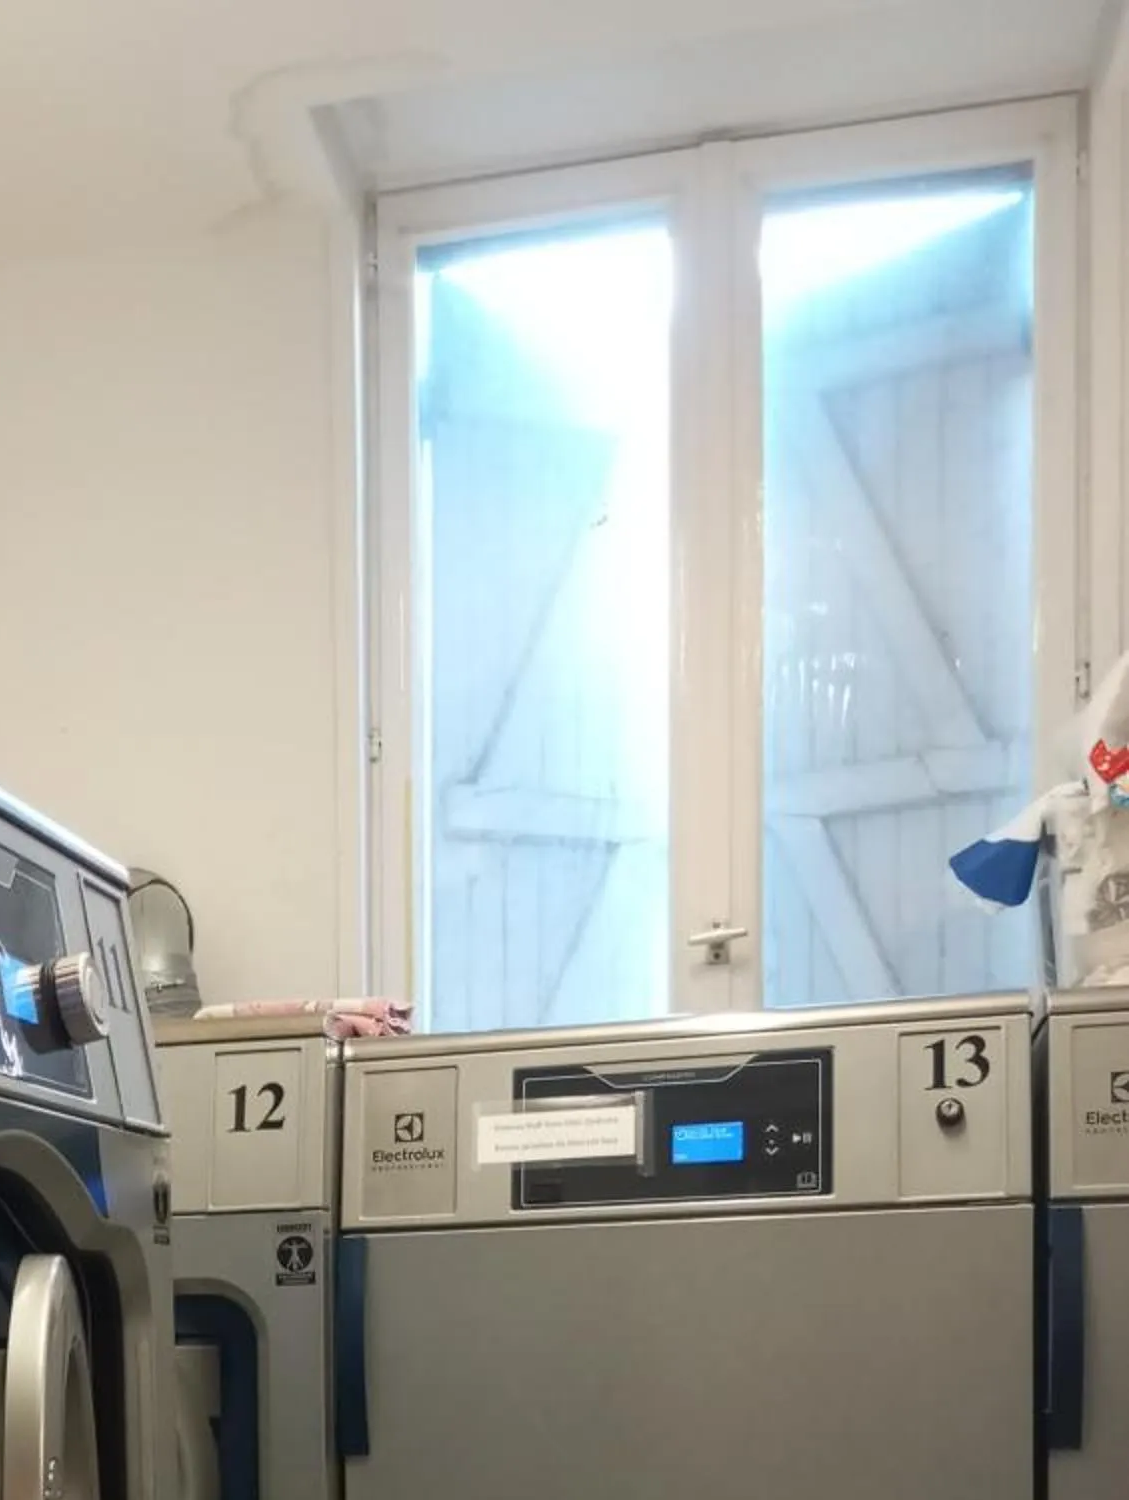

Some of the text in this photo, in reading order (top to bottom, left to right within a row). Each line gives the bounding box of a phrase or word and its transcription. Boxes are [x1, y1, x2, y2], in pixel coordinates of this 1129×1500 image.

[97, 936, 132, 1014] 11
[924, 1035, 990, 1091] 13
[227, 1082, 286, 1132] 12
[372, 1147, 445, 1163] Electrolux
